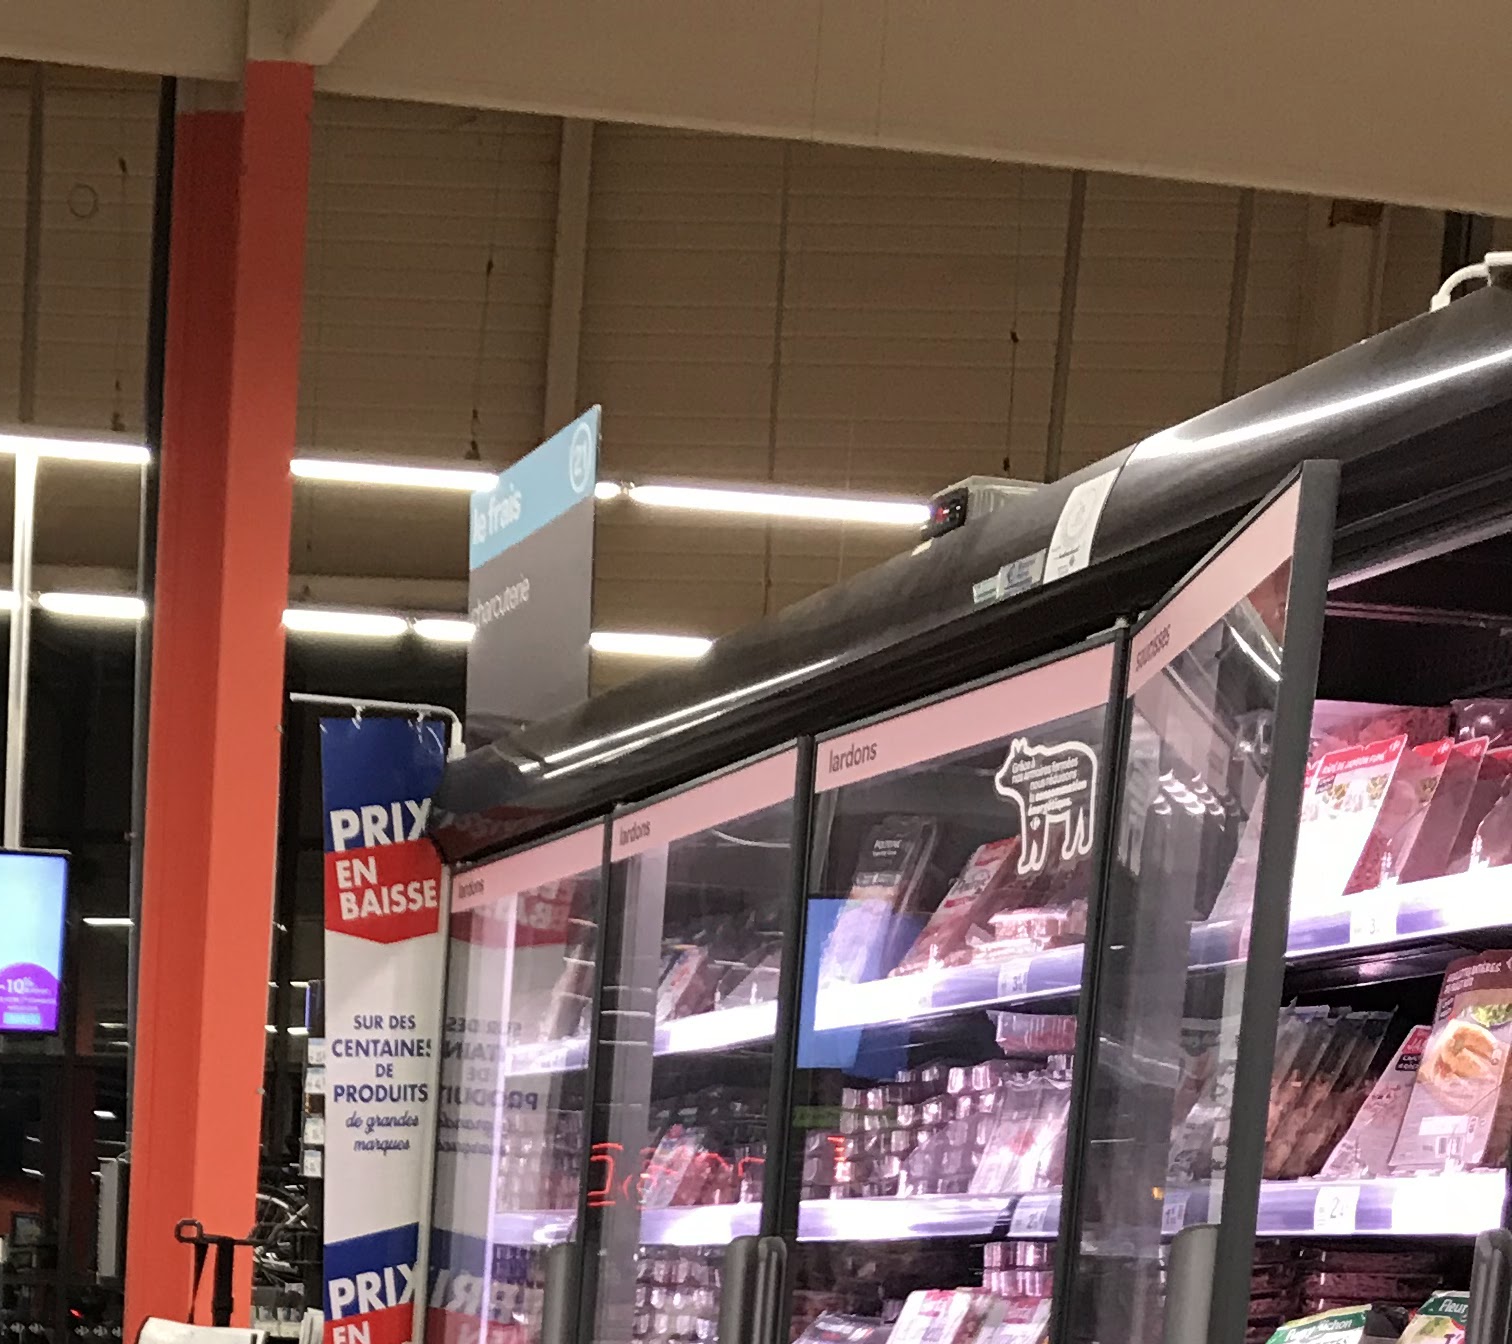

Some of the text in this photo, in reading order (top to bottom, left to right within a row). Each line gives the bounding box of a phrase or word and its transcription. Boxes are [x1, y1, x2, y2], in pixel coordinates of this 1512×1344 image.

[828, 741, 878, 774] lardons
[329, 798, 432, 852] PRIX
[619, 820, 651, 846] lardons
[336, 855, 378, 889] EN
[339, 878, 437, 921] BAISSE
[353, 1015, 416, 1030] SUR DES
[375, 1063, 394, 1079] DE
[333, 1084, 429, 1103] PRODUITS
[345, 1110, 419, 1134] de grandes
[353, 1138, 411, 1156] marques
[328, 1263, 418, 1321] PRIX
